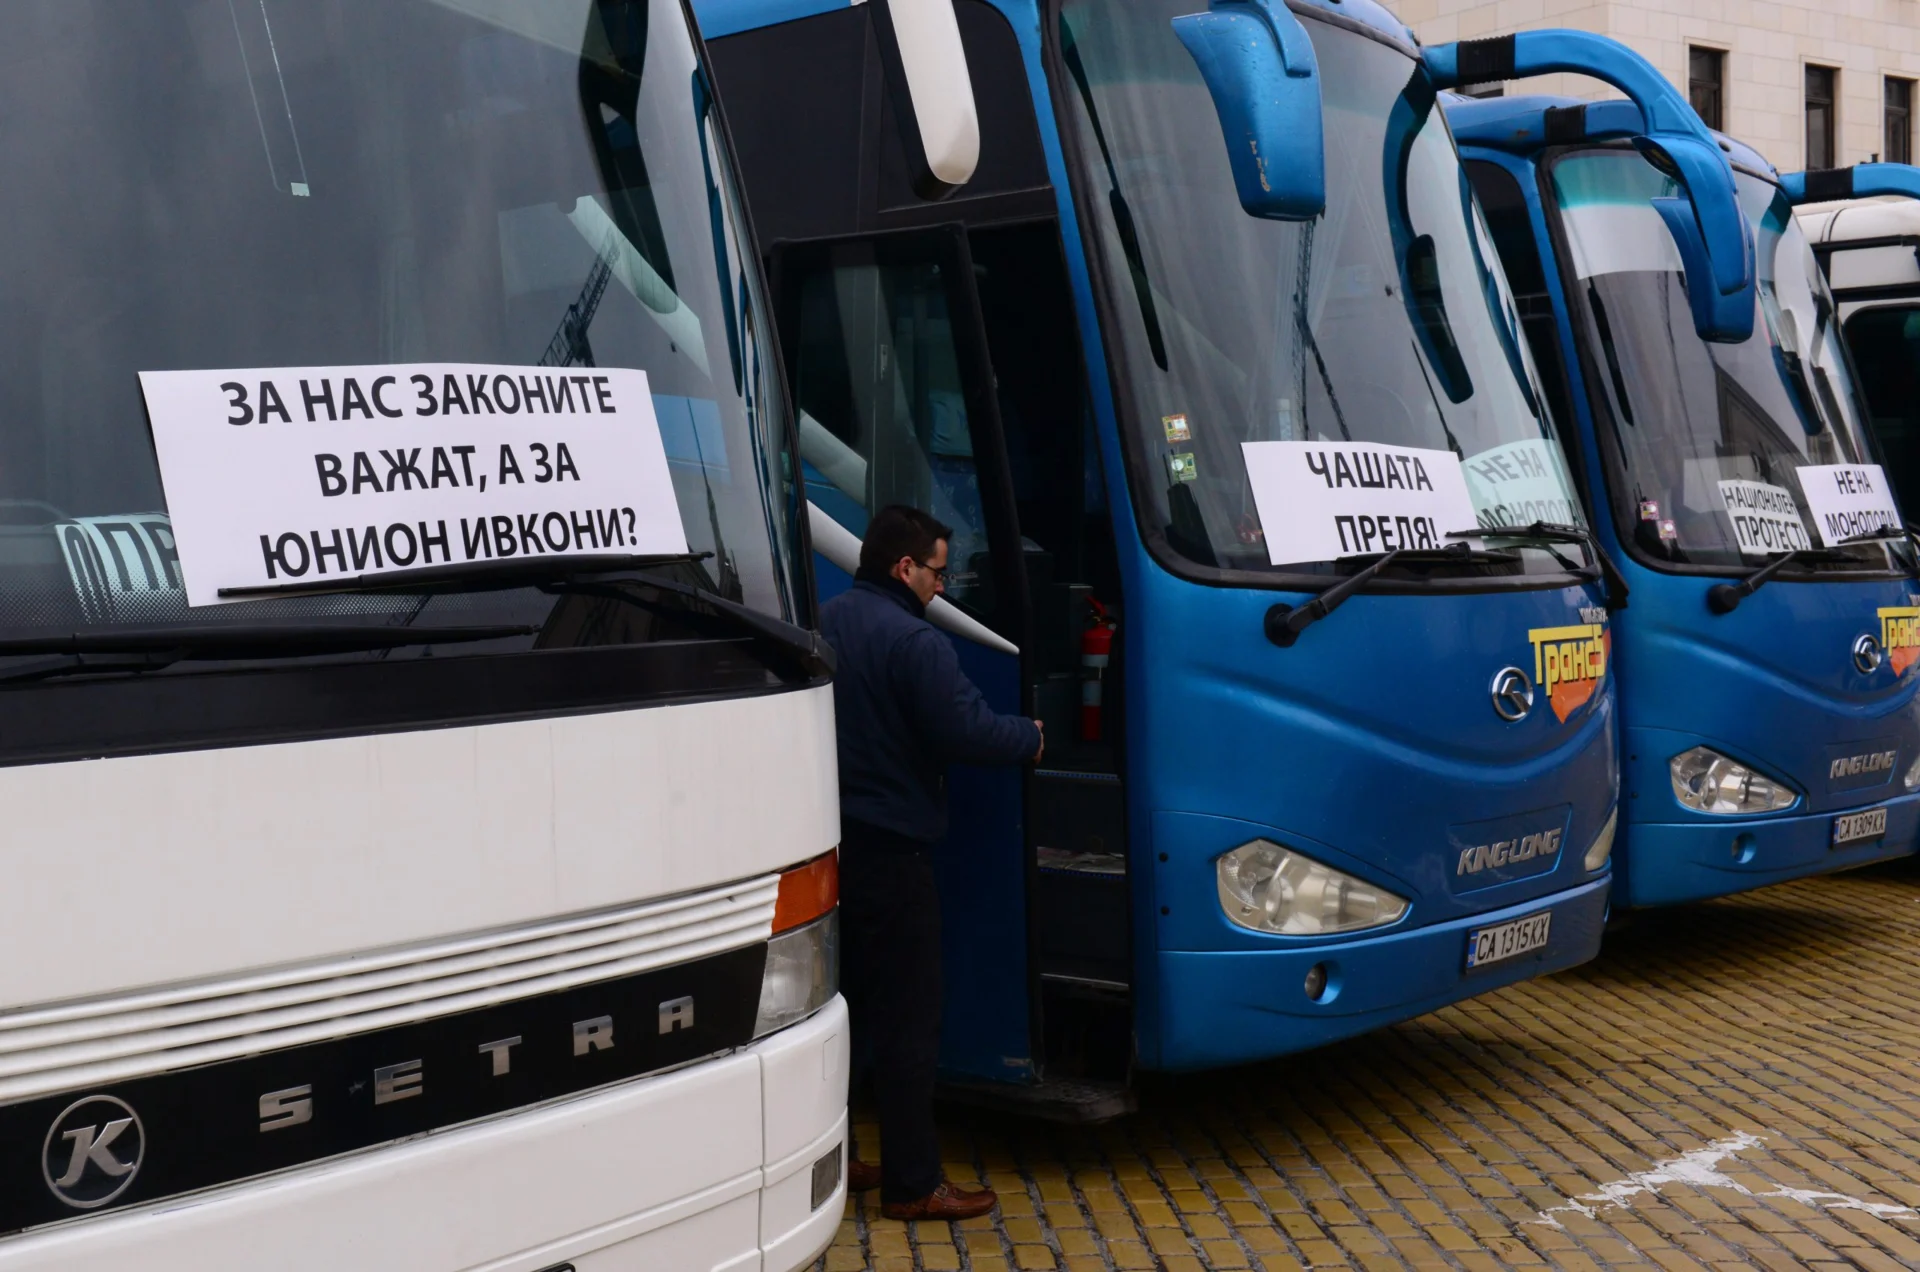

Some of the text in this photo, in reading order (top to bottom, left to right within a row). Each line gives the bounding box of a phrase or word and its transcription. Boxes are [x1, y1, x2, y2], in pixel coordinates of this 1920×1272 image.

[221, 374, 617, 426] ЗА НАС ЗАКОНИТЕ
[314, 442, 581, 497] ВАЖАТ, А ЗА
[1305, 451, 1434, 492] ЧАШАТА
[1468, 447, 1548, 484] НЕ НА
[1833, 470, 1874, 495] НЕ НА
[1721, 486, 1799, 515] НАЦИОНАЛЕН
[259, 506, 638, 580] ЮНИОН ИВКОНИ?
[1335, 515, 1440, 553] ПРЕЛЯ!
[1477, 932, 1497, 961] CA
[259, 995, 694, 1133] SETRA
